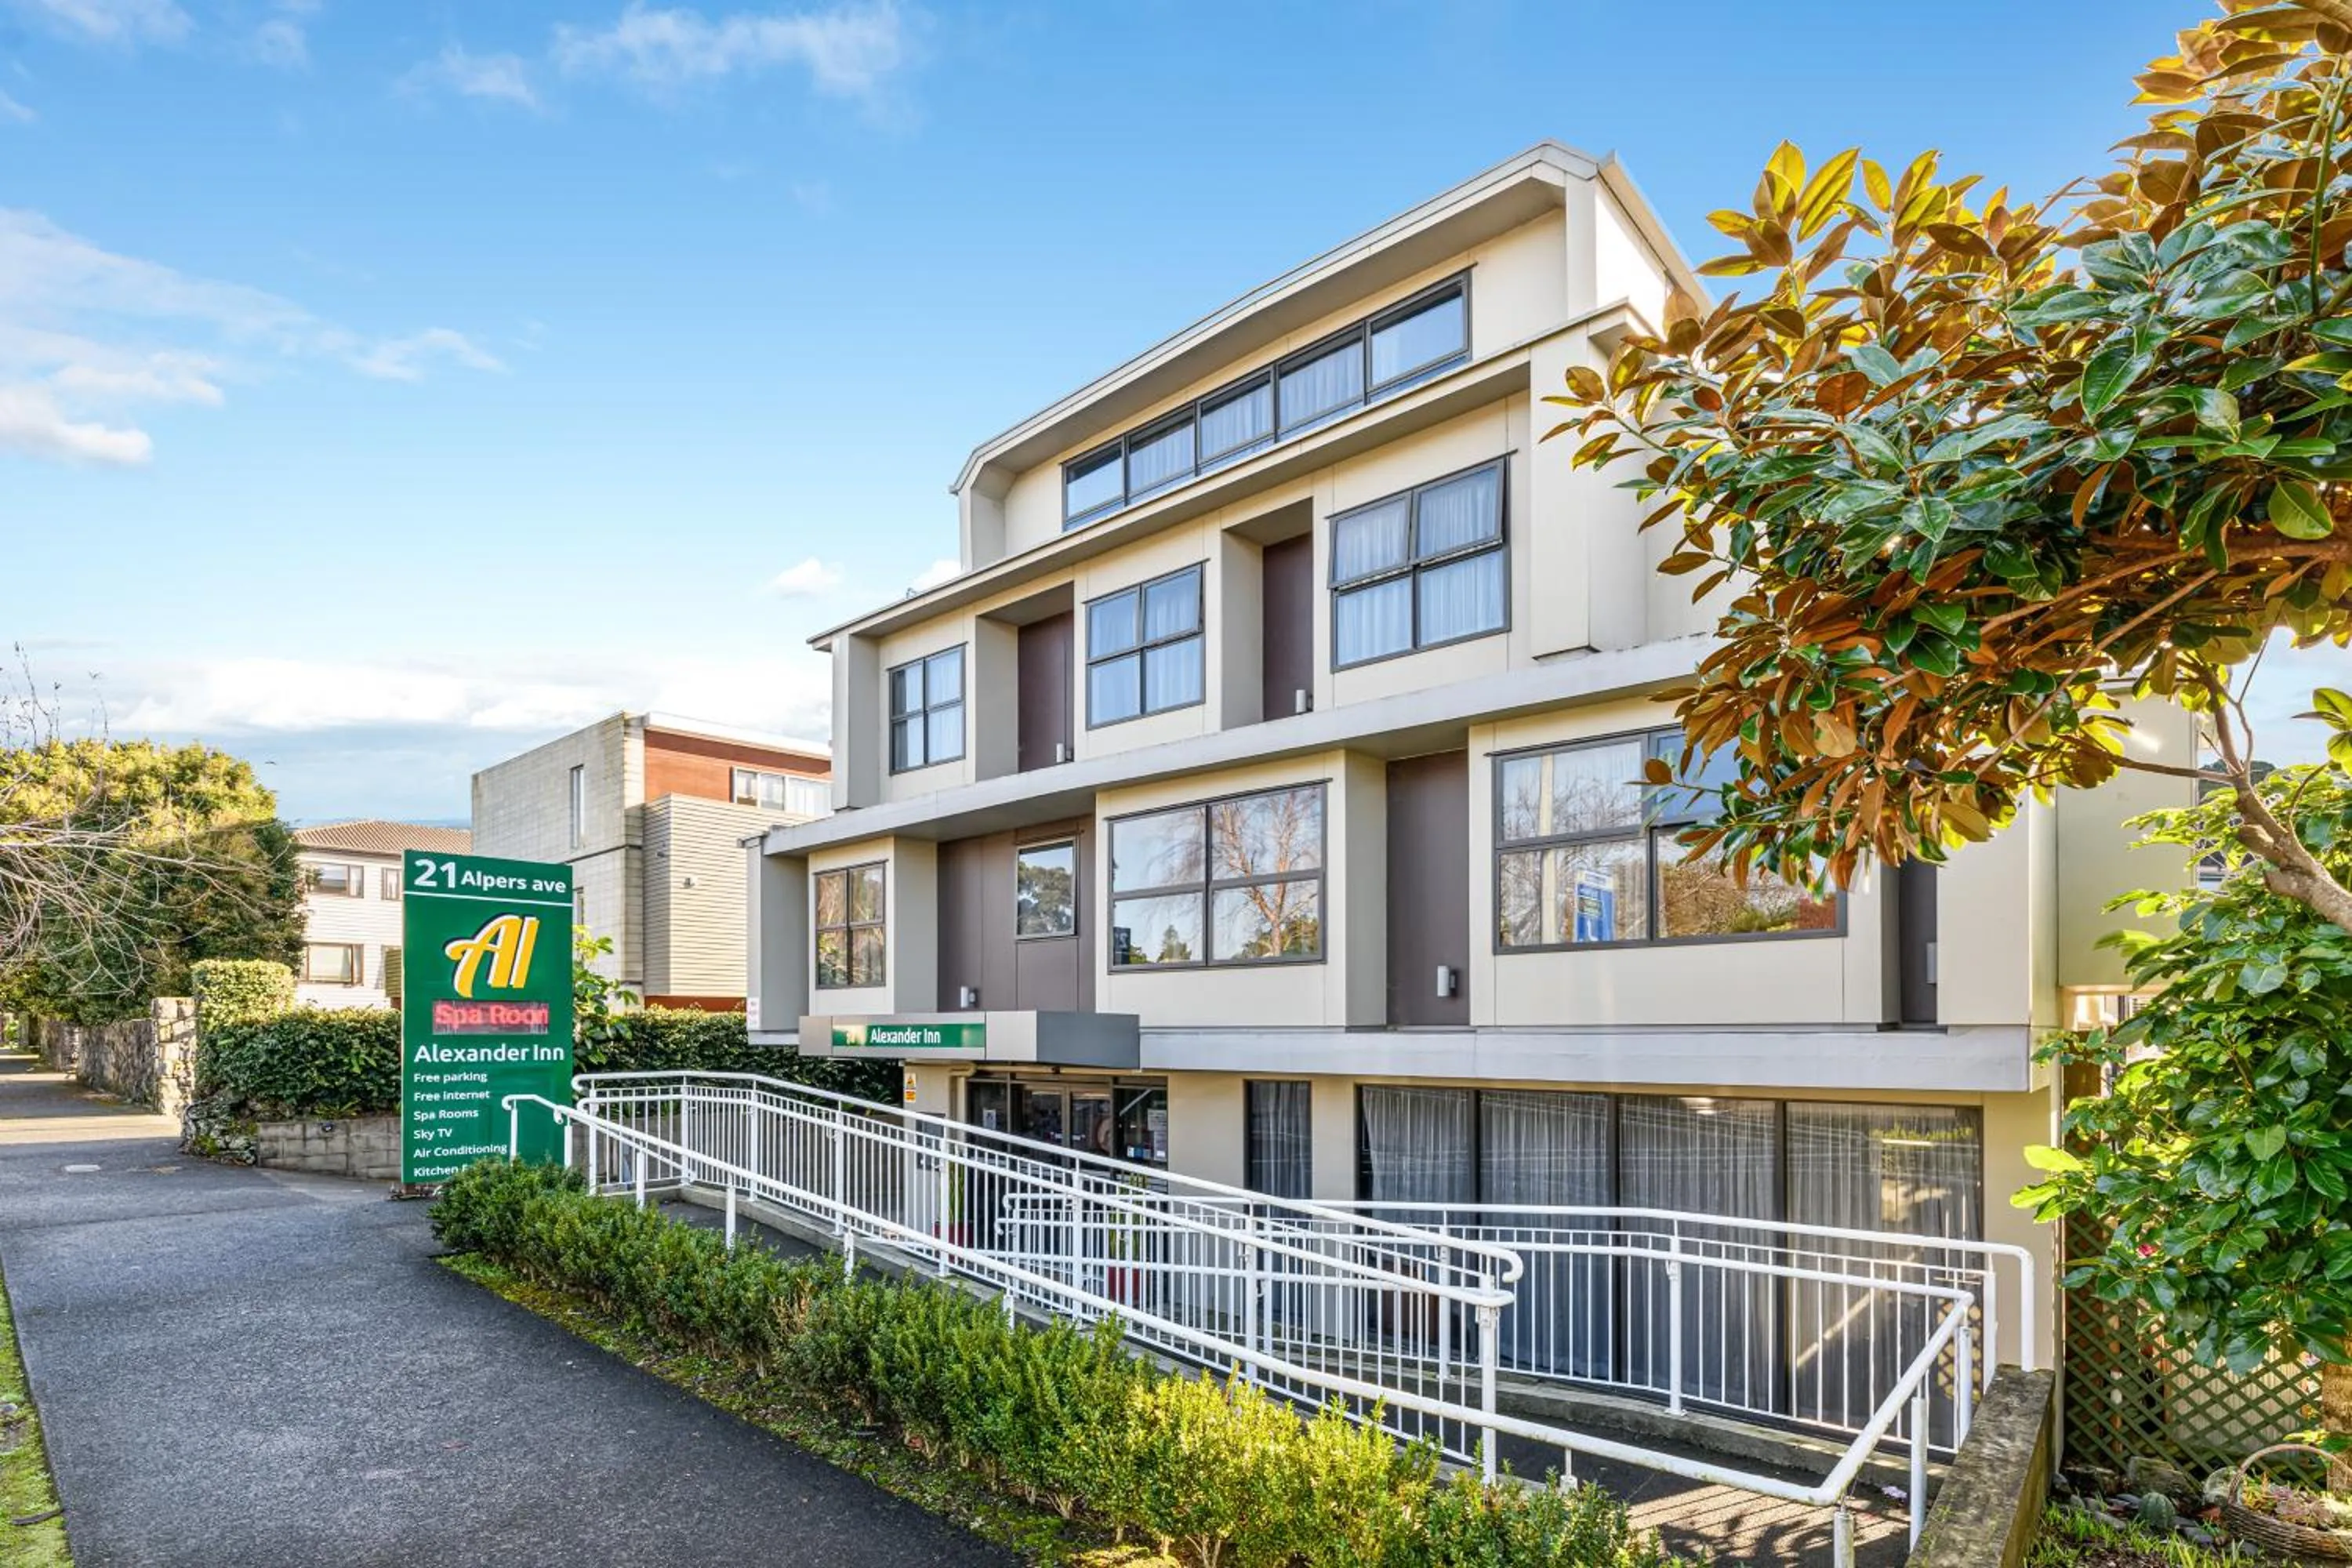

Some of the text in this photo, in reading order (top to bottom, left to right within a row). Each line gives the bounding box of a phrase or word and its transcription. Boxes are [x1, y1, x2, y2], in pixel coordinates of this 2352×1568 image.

[413, 858, 567, 893] 21 Alpers ave
[436, 1004, 482, 1029] Spa
[871, 1027, 922, 1044] Alexander
[924, 1028, 941, 1044] Inn
[413, 1043, 564, 1063] Alexander Inn
[413, 1072, 488, 1083] Free parking
[413, 1091, 490, 1102] Free internet
[413, 1109, 479, 1122] Spa Rooms
[413, 1128, 452, 1141] Sky TV
[413, 1144, 507, 1158] Air Conditioning
[413, 1165, 459, 1177] Kitchen
